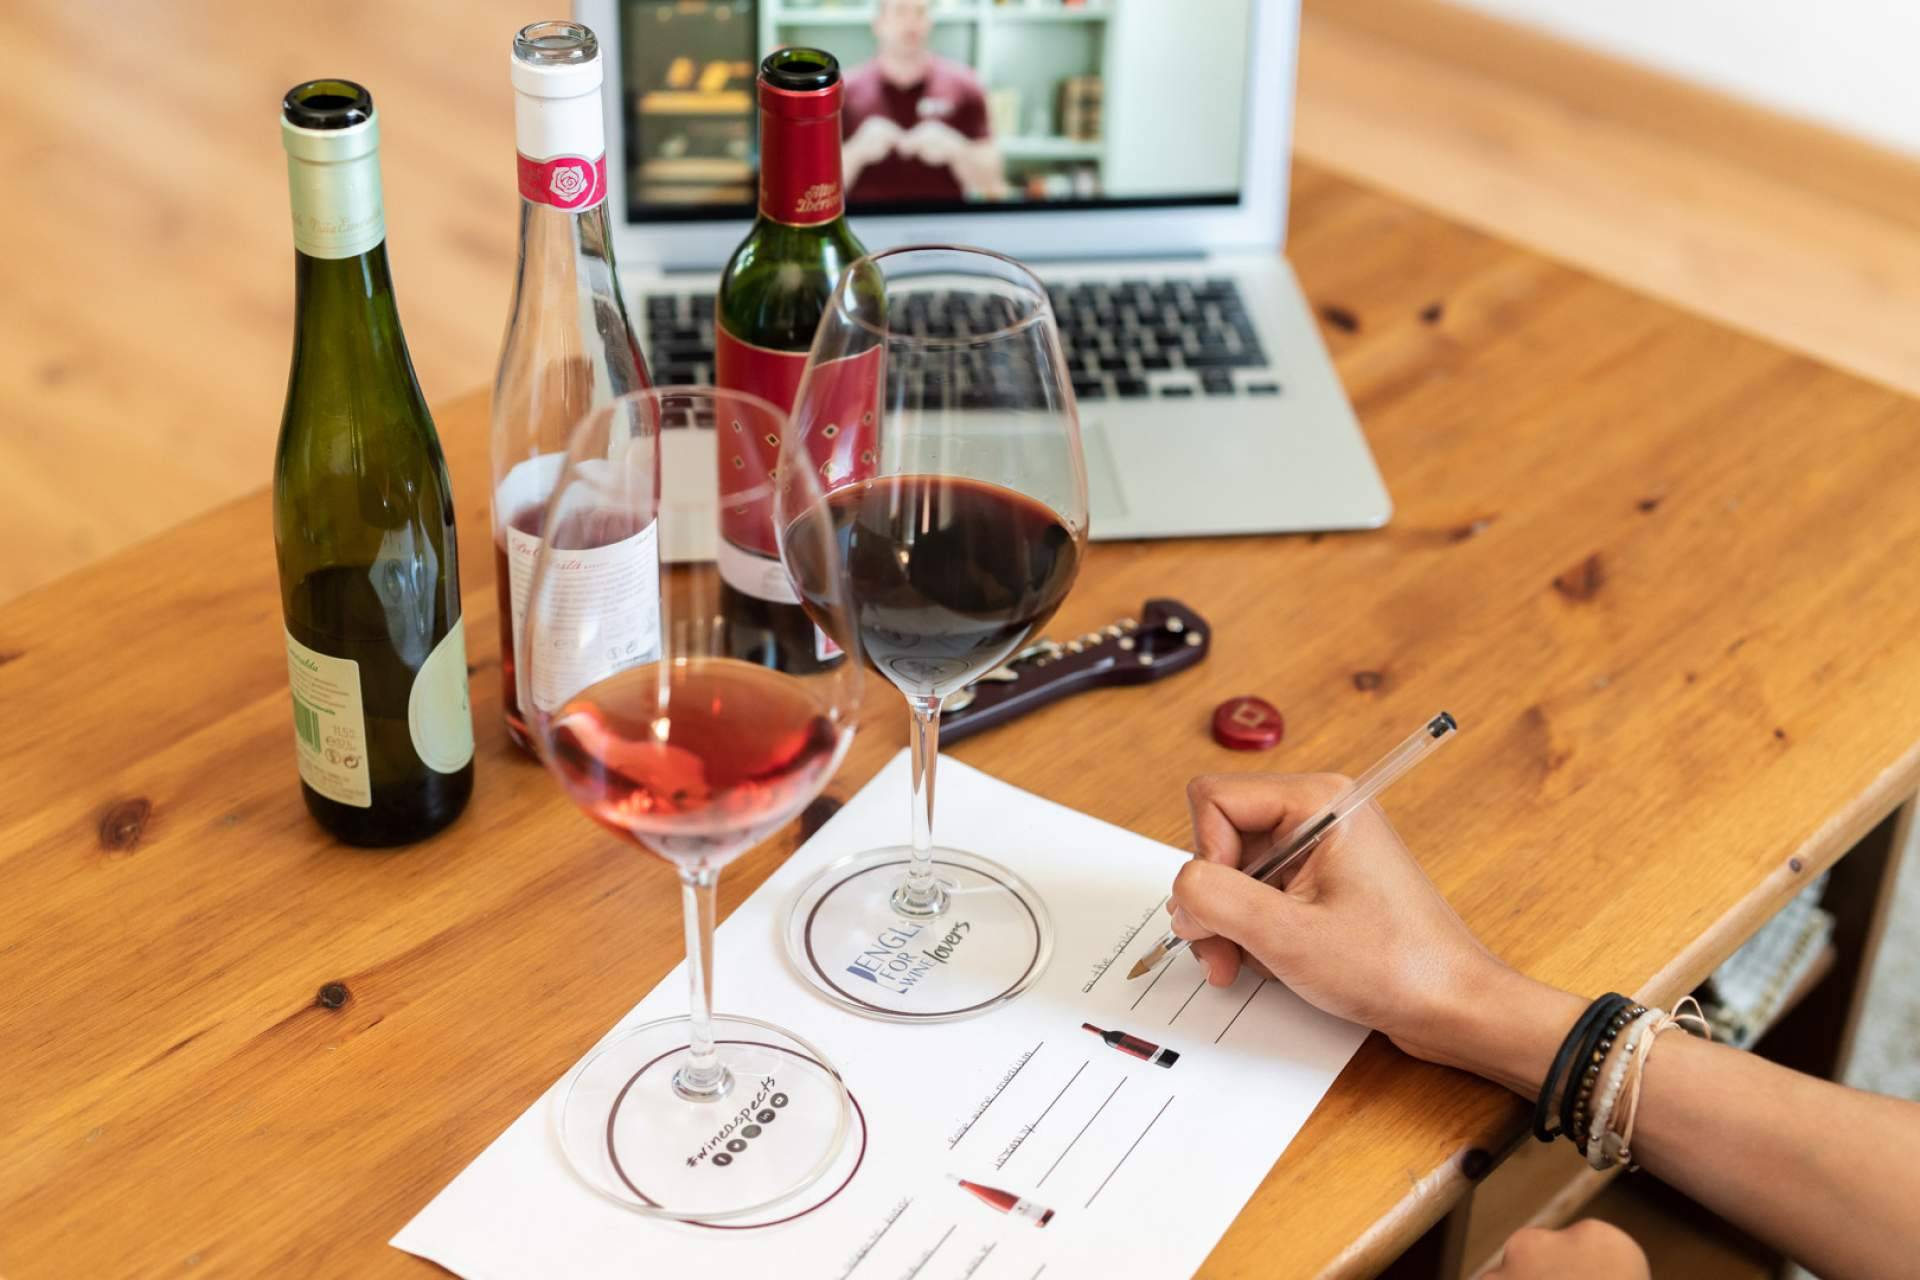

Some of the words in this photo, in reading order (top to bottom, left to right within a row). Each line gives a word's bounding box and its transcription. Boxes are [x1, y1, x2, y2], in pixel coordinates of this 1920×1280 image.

[879, 952, 919, 981] FOR
[899, 957, 937, 986] WINE
[921, 920, 971, 965] lovers
[686, 1076, 775, 1167] #wineaspects
